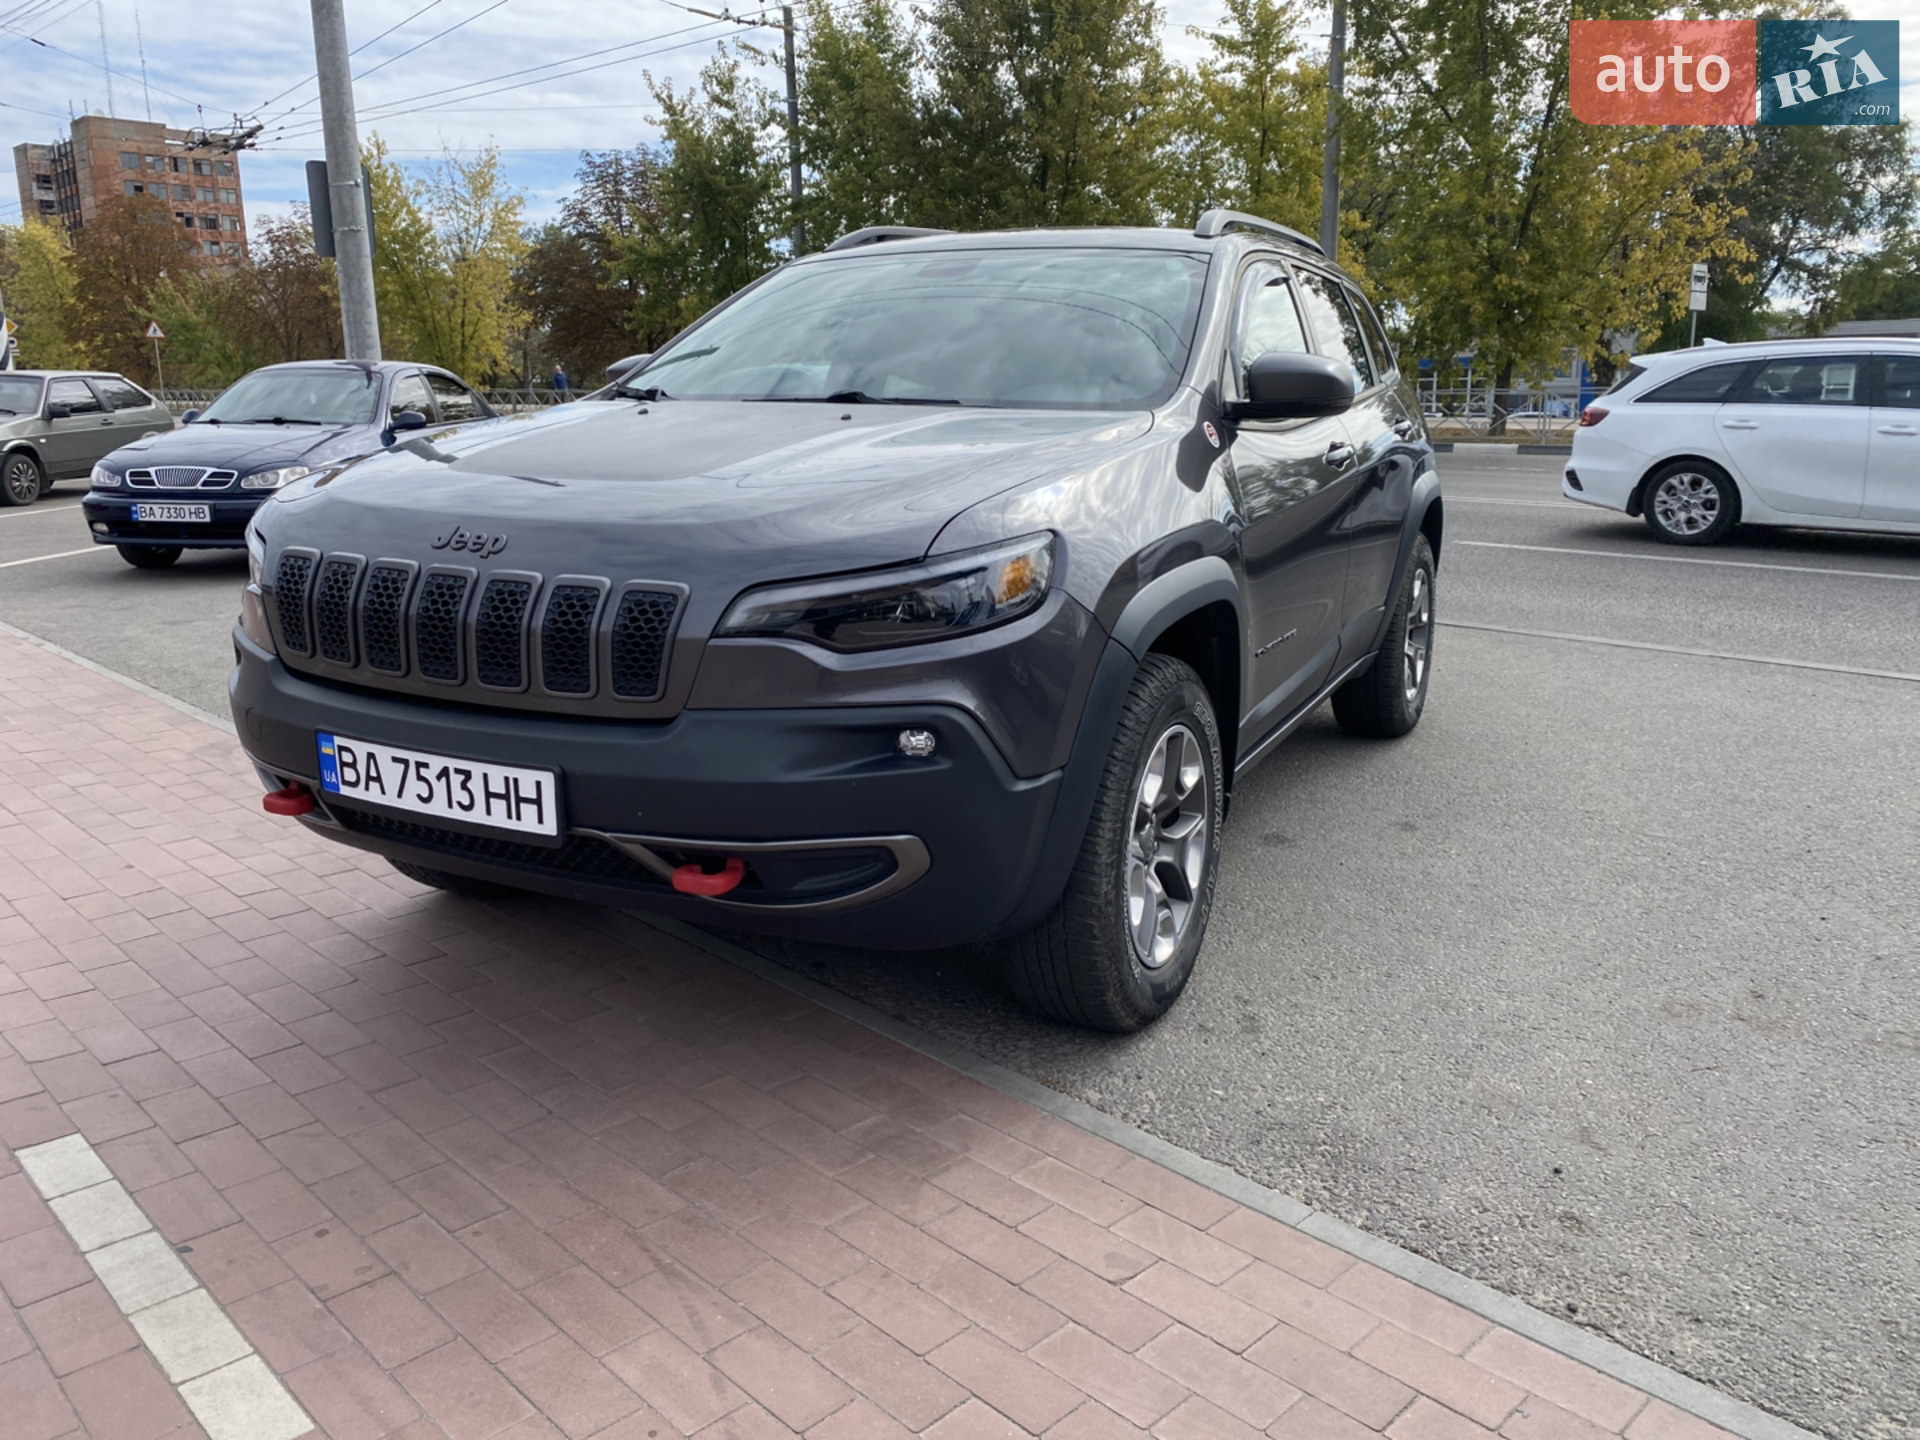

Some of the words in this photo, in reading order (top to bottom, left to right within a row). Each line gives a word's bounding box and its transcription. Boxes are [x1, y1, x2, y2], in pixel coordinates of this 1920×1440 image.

[139, 506, 156, 519] BA
[158, 507, 186, 519] 7330
[188, 507, 206, 520] HB
[430, 526, 508, 559] Jeep
[323, 769, 338, 785] UA
[336, 744, 387, 796] BA
[391, 756, 476, 813] 7513
[482, 772, 545, 825] HH
